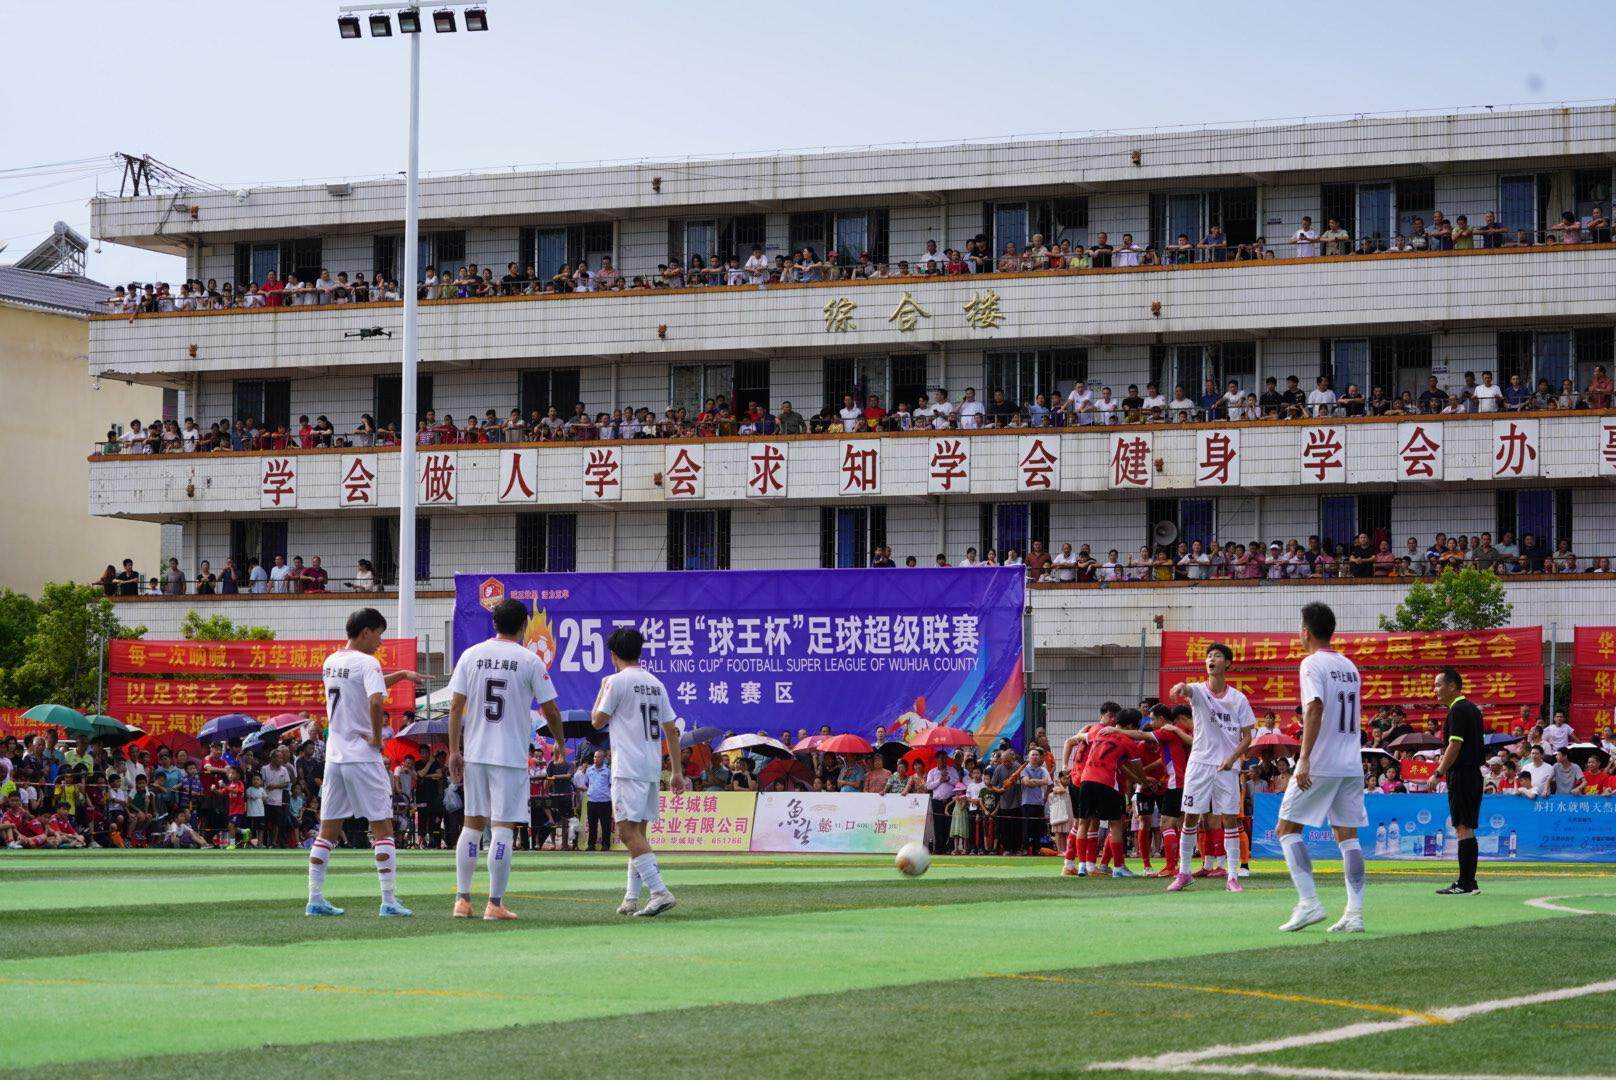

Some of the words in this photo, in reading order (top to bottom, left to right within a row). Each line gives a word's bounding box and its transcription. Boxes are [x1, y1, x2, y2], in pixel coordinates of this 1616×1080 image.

[823, 288, 1006, 332] 综合楼
[559, 618, 605, 673] 25
[612, 614, 980, 657] 华县“球王杯”足球超级联赛
[476, 659, 518, 671] 中铁上海局
[670, 658, 695, 673] KING
[699, 658, 723, 673] CUP"
[727, 658, 783, 672] FOOTBALL
[787, 658, 821, 672] SUPER
[825, 658, 867, 672] LEAGUE
[870, 658, 885, 671] OF
[889, 658, 930, 671] WUHUA
[934, 658, 979, 671] COUNTY
[126, 682, 248, 705] 以足球之名
[328, 686, 341, 722] 7
[485, 677, 507, 723] 5
[677, 682, 794, 704] 华城赛区
[640, 703, 660, 741] 16
[1338, 690, 1356, 734] 11
[845, 820, 856, 830] 口
[874, 819, 889, 834] 酒
